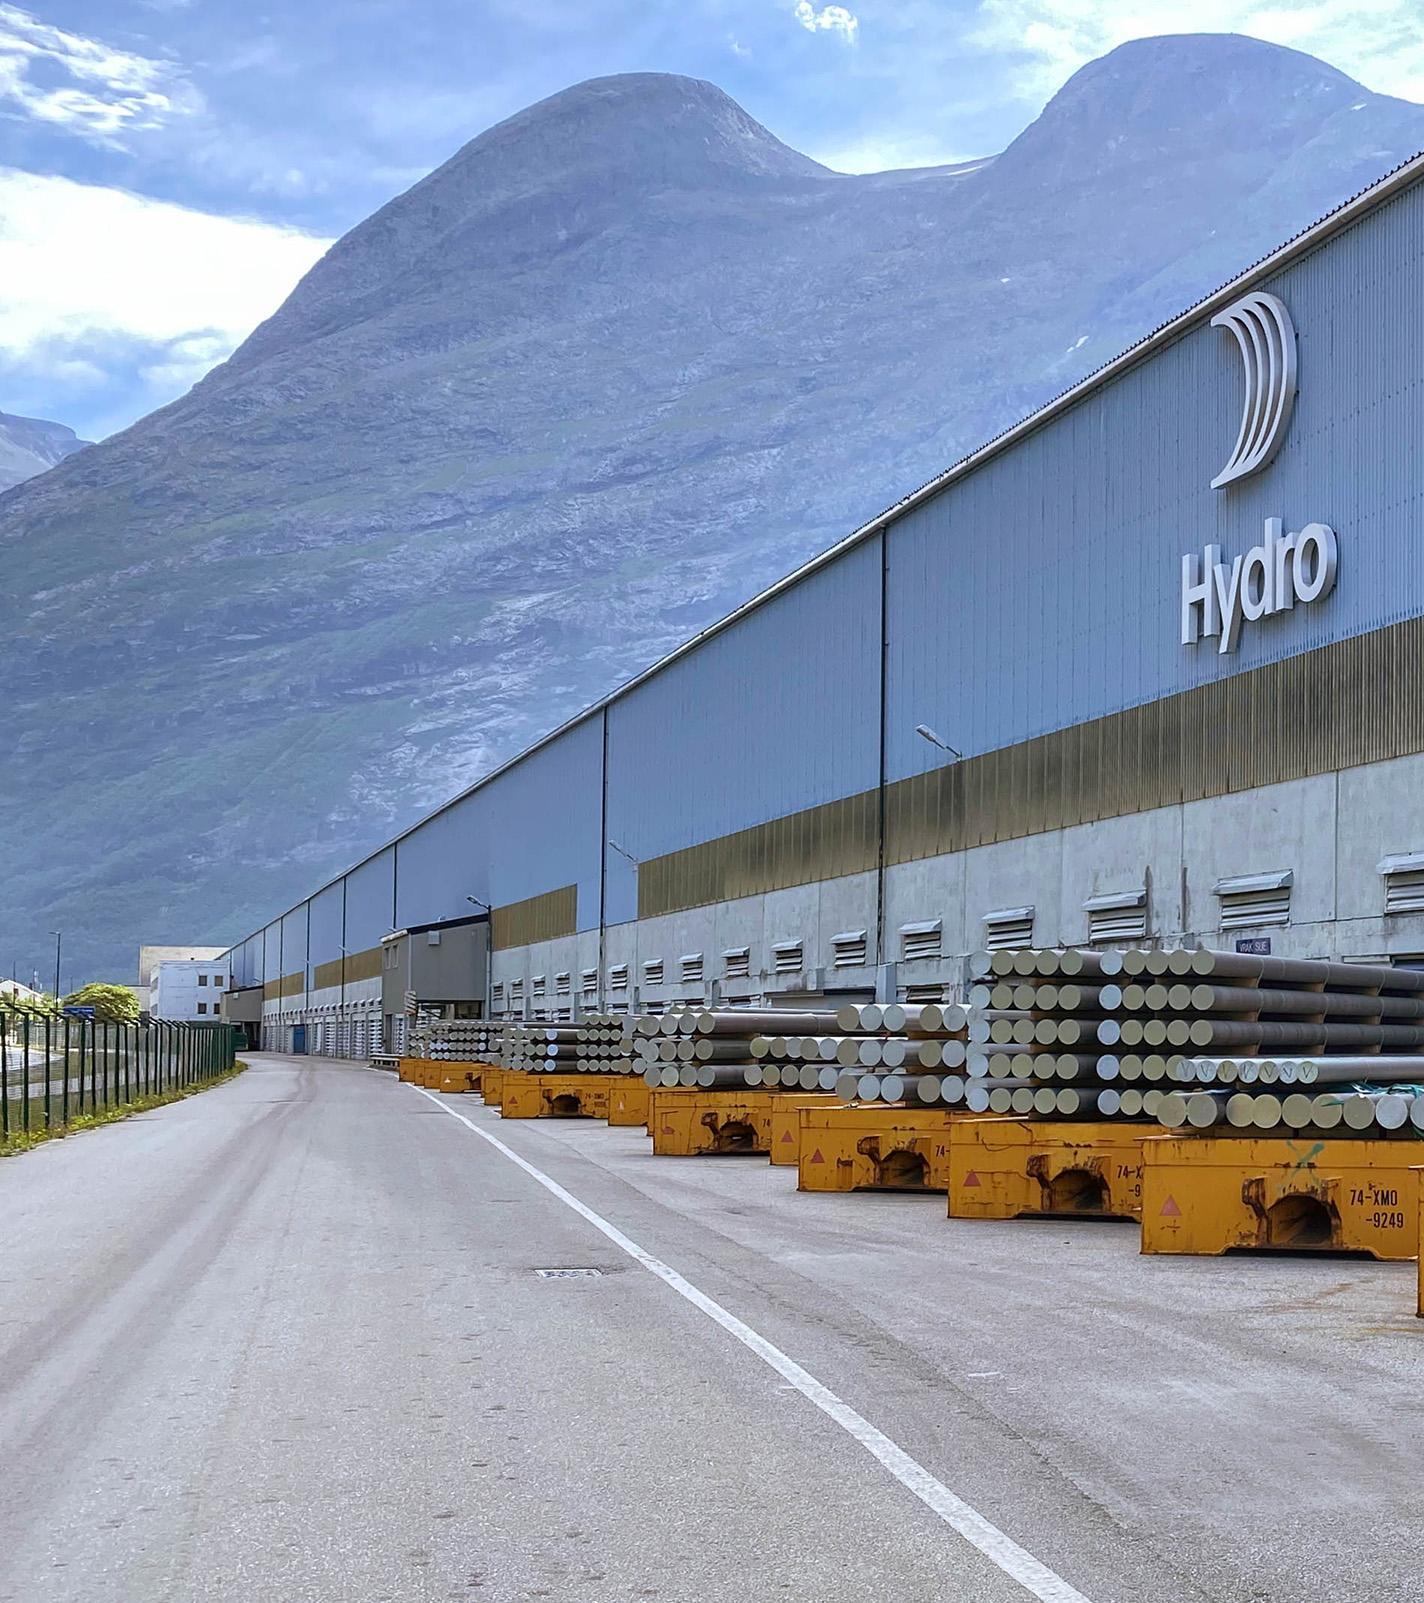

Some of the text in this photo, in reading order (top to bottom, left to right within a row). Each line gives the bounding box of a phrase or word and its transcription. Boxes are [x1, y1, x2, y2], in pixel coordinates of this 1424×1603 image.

[1181, 517, 1337, 653] Hydro
[1254, 941, 1267, 952] SUE
[1365, 1211, 1404, 1229] -9249
